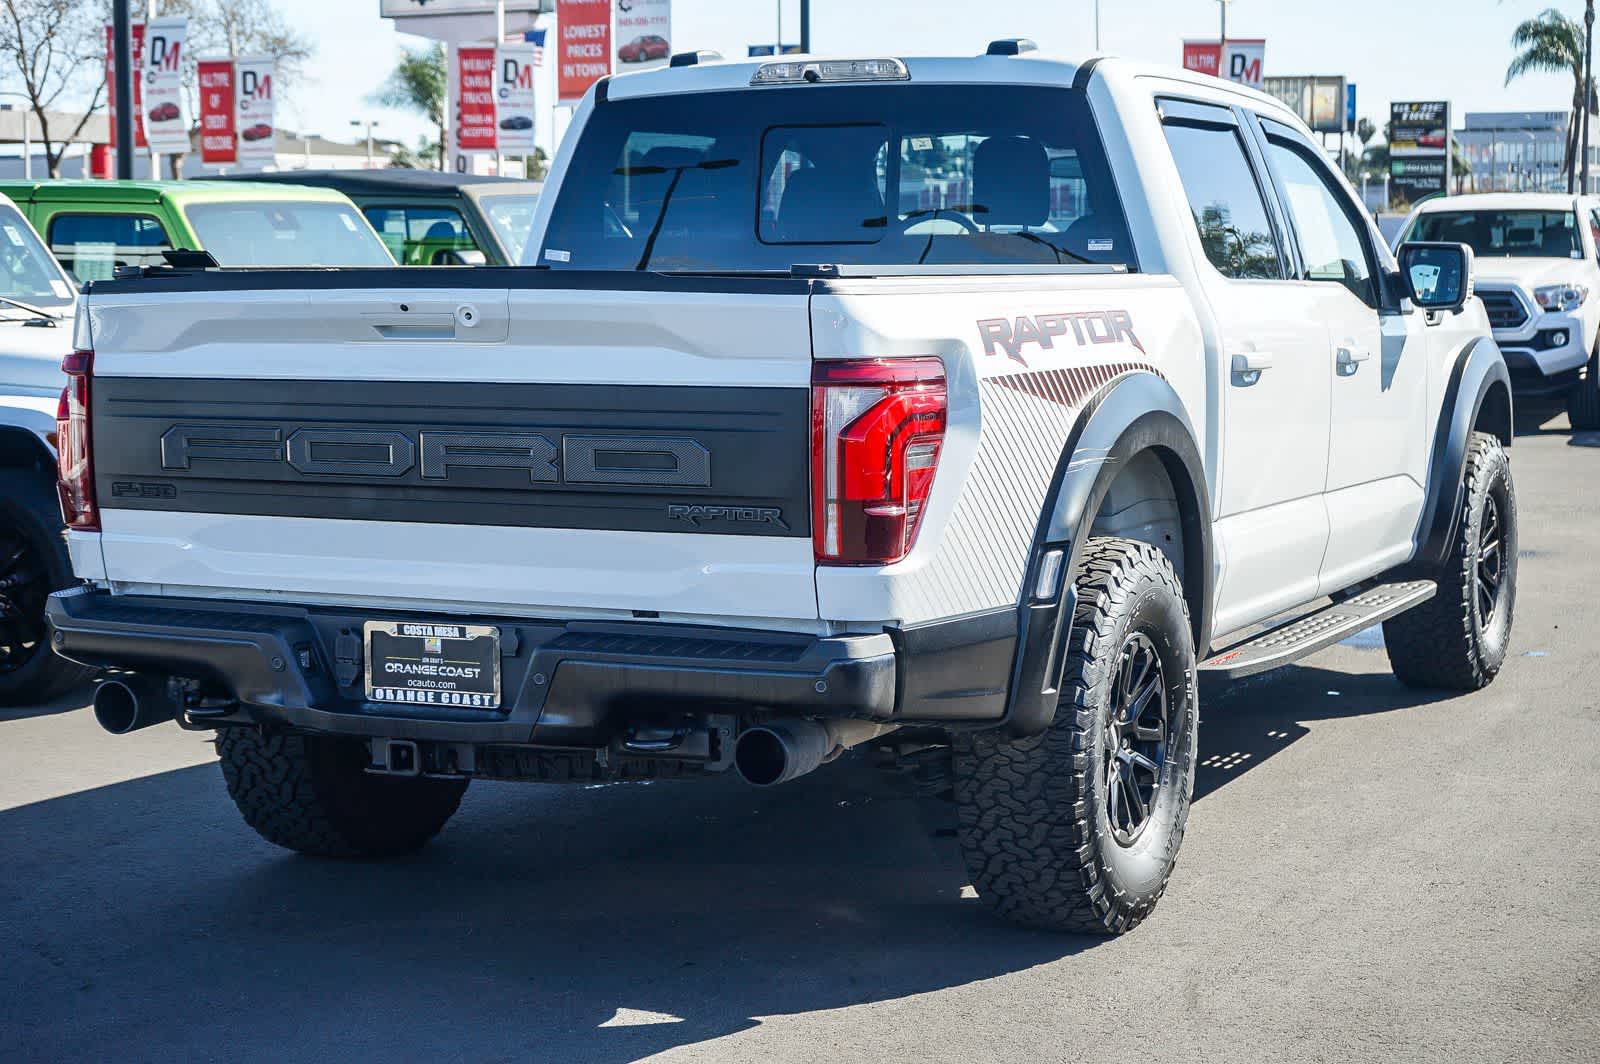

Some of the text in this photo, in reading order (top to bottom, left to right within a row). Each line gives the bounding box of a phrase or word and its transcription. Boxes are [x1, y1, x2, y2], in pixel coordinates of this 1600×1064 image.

[563, 24, 607, 39] LOWEST
[151, 36, 181, 72] DM
[567, 43, 603, 58] PRICES
[1199, 53, 1216, 69] TYPE
[503, 59, 533, 89] DM
[563, 63, 608, 78] IN TOWN
[1230, 53, 1261, 84] DM
[242, 71, 273, 100] DM
[976, 309, 1147, 368] RAPTOR
[160, 423, 712, 488] FORD
[667, 503, 791, 531] RAPTOR
[403, 624, 460, 638] COSTA MESA
[407, 679, 456, 689] ocauto.com
[375, 688, 491, 706] ORANGE COAST
